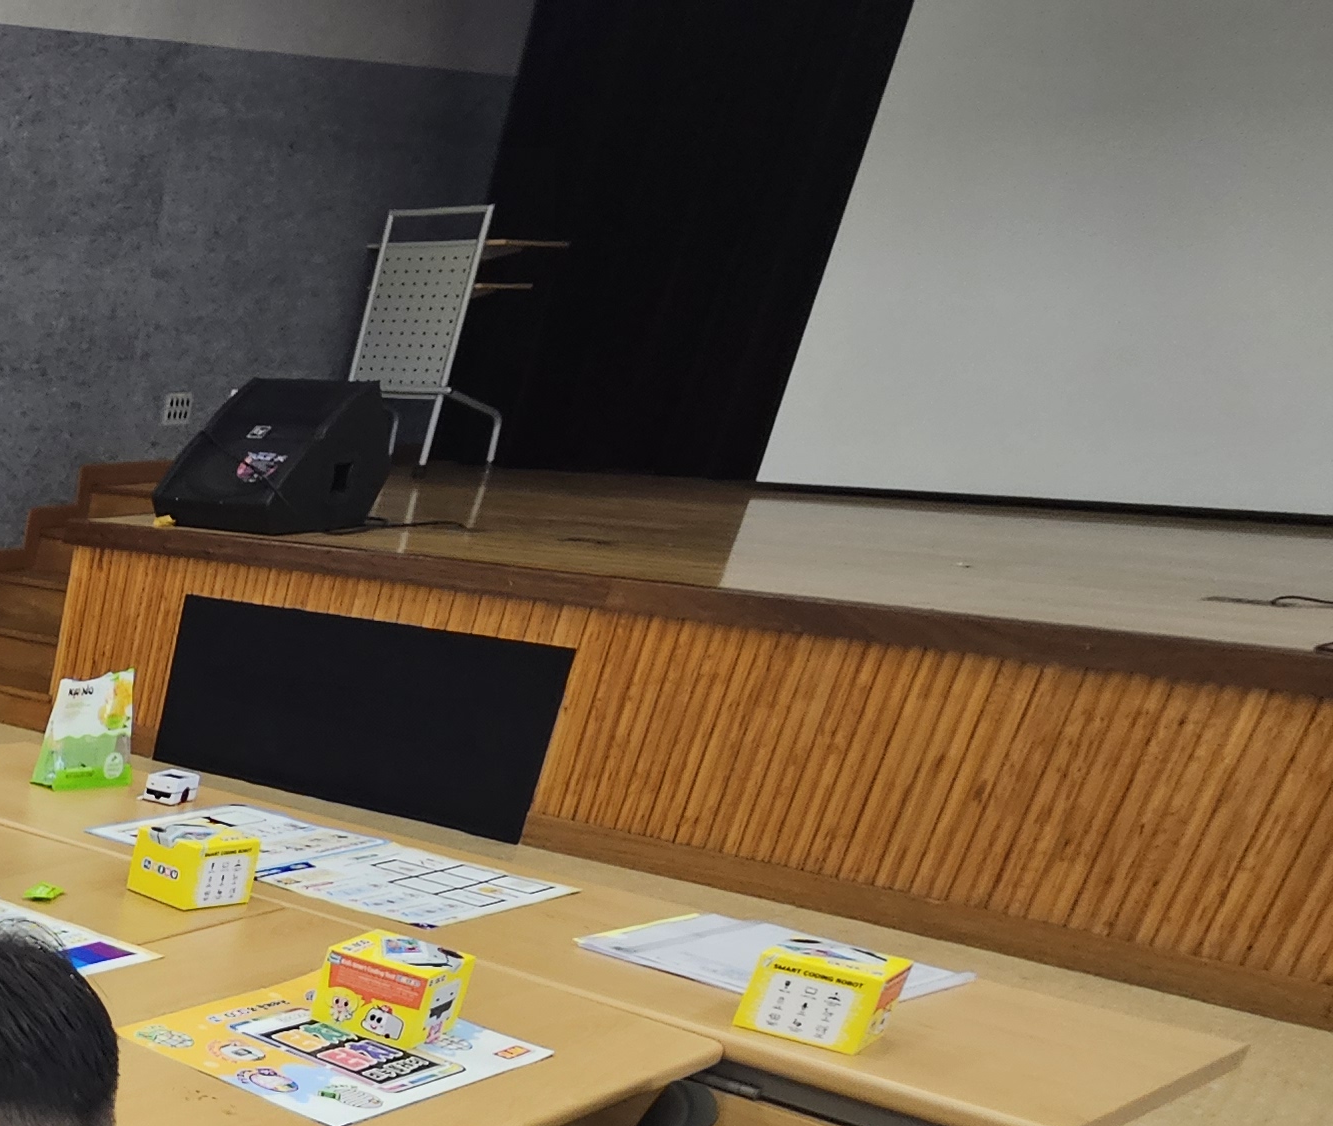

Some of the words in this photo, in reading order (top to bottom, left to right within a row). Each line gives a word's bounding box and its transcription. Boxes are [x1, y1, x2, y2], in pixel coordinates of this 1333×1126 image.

[773, 963, 802, 976] SMART
[803, 970, 834, 983] CODING
[836, 977, 864, 989] ROBOT
